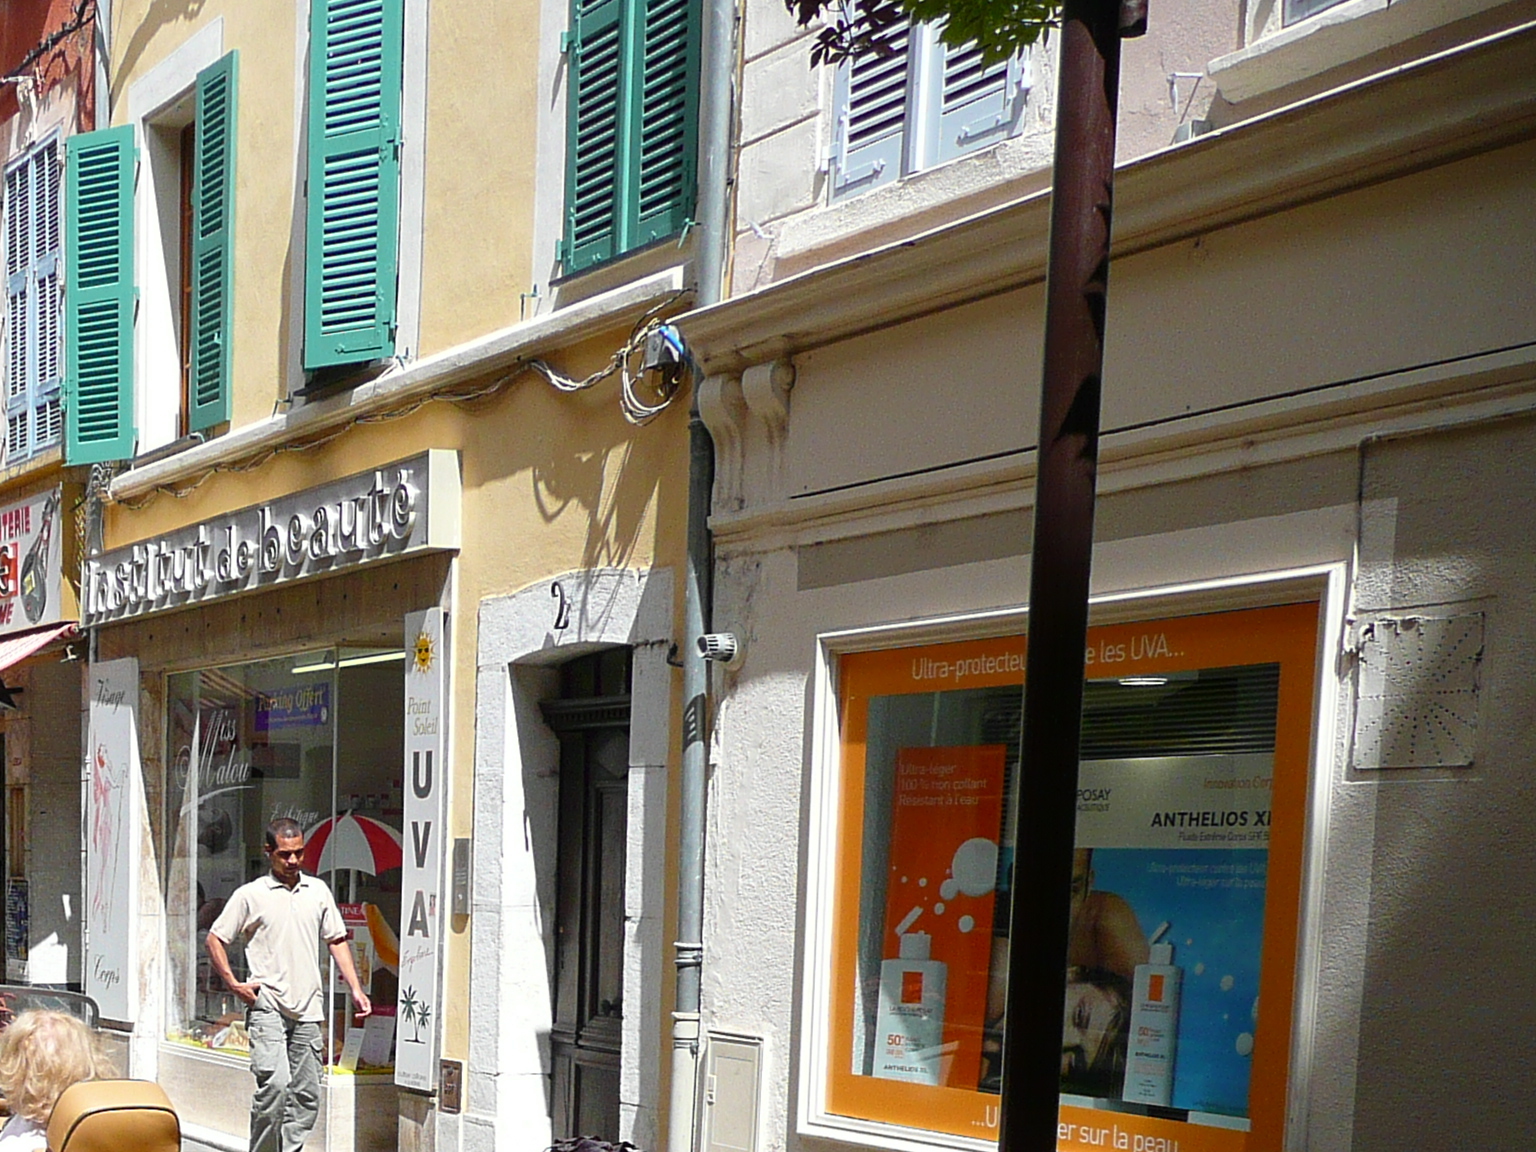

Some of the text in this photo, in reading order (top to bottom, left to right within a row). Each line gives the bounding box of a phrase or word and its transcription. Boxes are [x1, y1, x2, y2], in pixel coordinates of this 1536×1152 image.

[216, 525, 254, 582] de
[258, 469, 418, 573] beauté
[551, 581, 571, 630] 2
[912, 652, 1027, 682] Ultra-protecteu
[1100, 642, 1125, 662] les
[1130, 633, 1185, 661] UVA...
[96, 678, 125, 715] Visage
[296, 686, 324, 711] Offert
[407, 697, 431, 715] Point
[413, 717, 438, 736] Soleil
[1150, 811, 1249, 827] ANTHELIOS
[94, 953, 120, 990] Corps
[1079, 1126, 1106, 1146] sur
[1113, 1124, 1128, 1149] la
